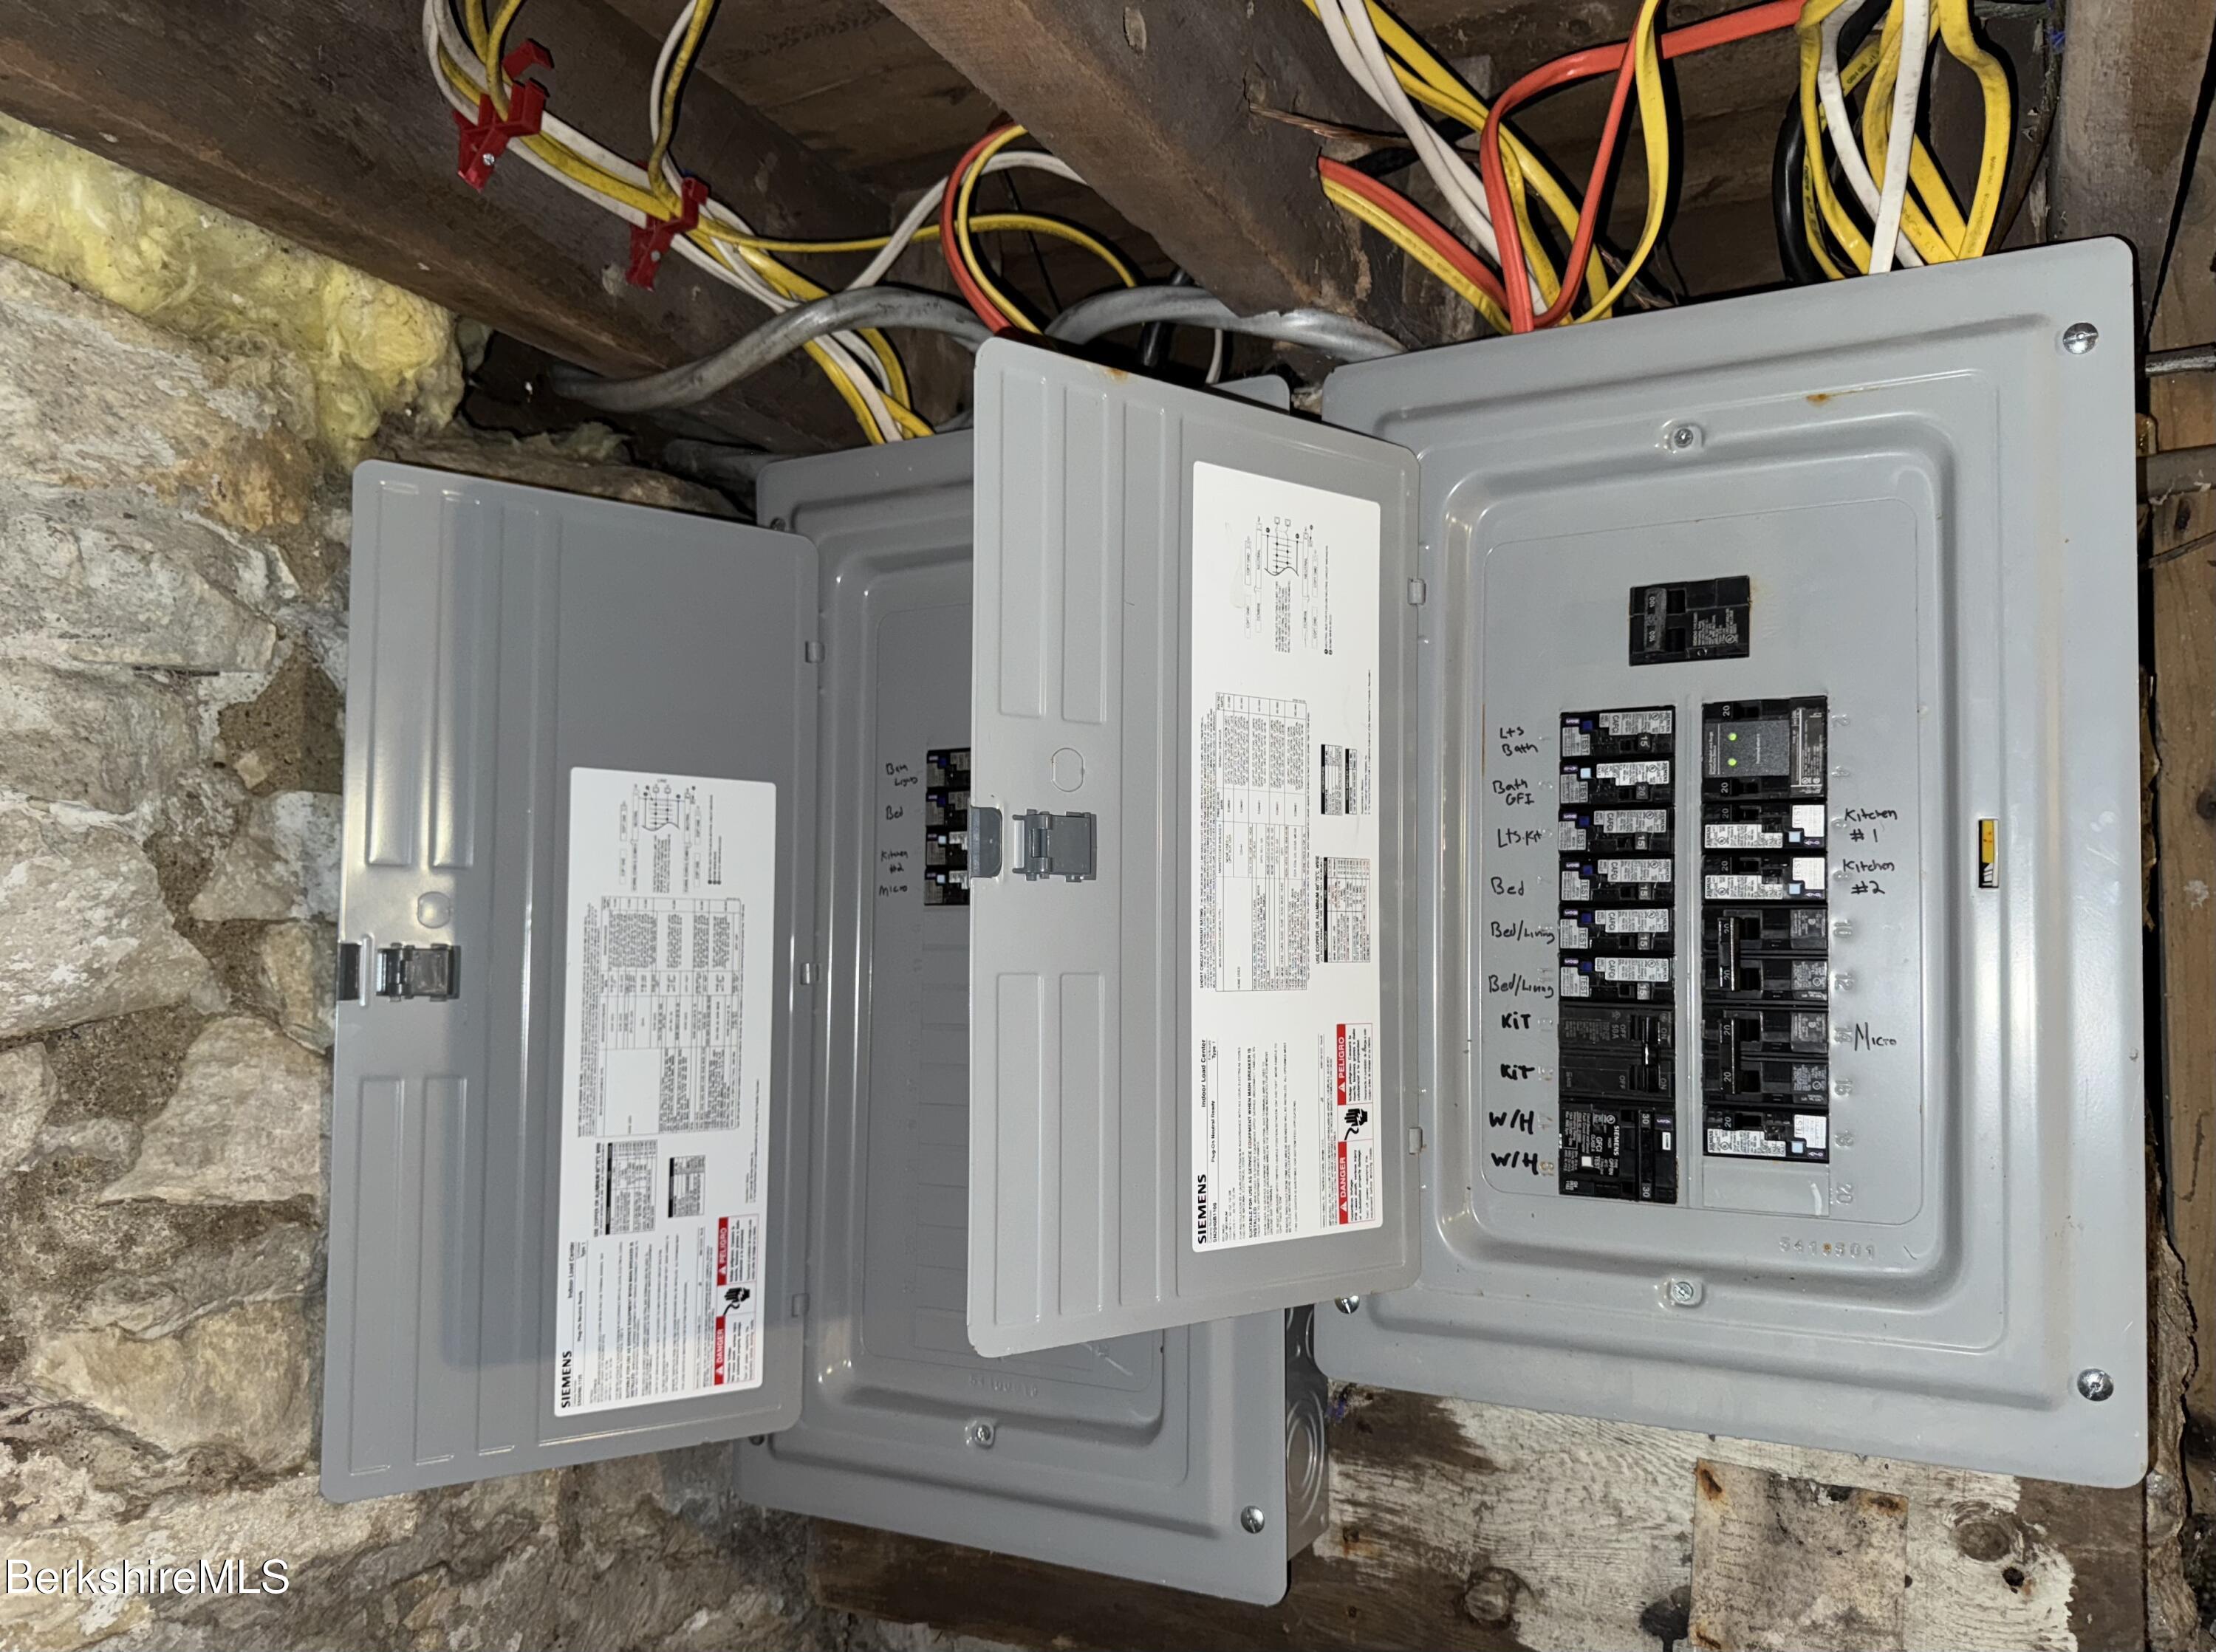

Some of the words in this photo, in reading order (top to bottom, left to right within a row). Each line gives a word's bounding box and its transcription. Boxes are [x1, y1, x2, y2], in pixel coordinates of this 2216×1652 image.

[1723, 705, 1731, 717] 20
[1612, 714, 1620, 734] CAFCI
[1641, 736, 1648, 747] 15
[1502, 743, 1539, 757] Bath
[1492, 778, 1528, 795] Bath
[1638, 786, 1646, 797] 20
[1721, 781, 1728, 794] 20
[1506, 792, 1535, 806] GFI
[886, 805, 903, 820] Bed
[1721, 808, 1729, 819] 20
[1844, 808, 1898, 823] Kitchen
[1638, 836, 1645, 848] 15
[1721, 860, 1728, 871] 20
[1843, 858, 1895, 873] Kitchen
[879, 885, 908, 897] Micro
[1491, 877, 1525, 896] Bed
[1641, 885, 1648, 897] 15
[1640, 936, 1648, 947] 15
[1639, 984, 1647, 996] 15
[1661, 1027, 1667, 1040] ON
[1723, 1024, 1731, 1036] 20
[1854, 1022, 1897, 1052] Micro
[1661, 1077, 1666, 1090] ON
[1723, 1072, 1731, 1083] 20
[1489, 1109, 1534, 1135] W/H
[1642, 1113, 1649, 1124] 30
[1724, 1117, 1732, 1128] 20
[1491, 1151, 1539, 1175] W/H
[1643, 1186, 1650, 1197] 30
[1197, 1173, 1207, 1244] SIEMENS
[719, 1227, 728, 1263] PELIGRO
[717, 1329, 725, 1364] DANGER
[561, 1350, 572, 1408] SIEMENS
